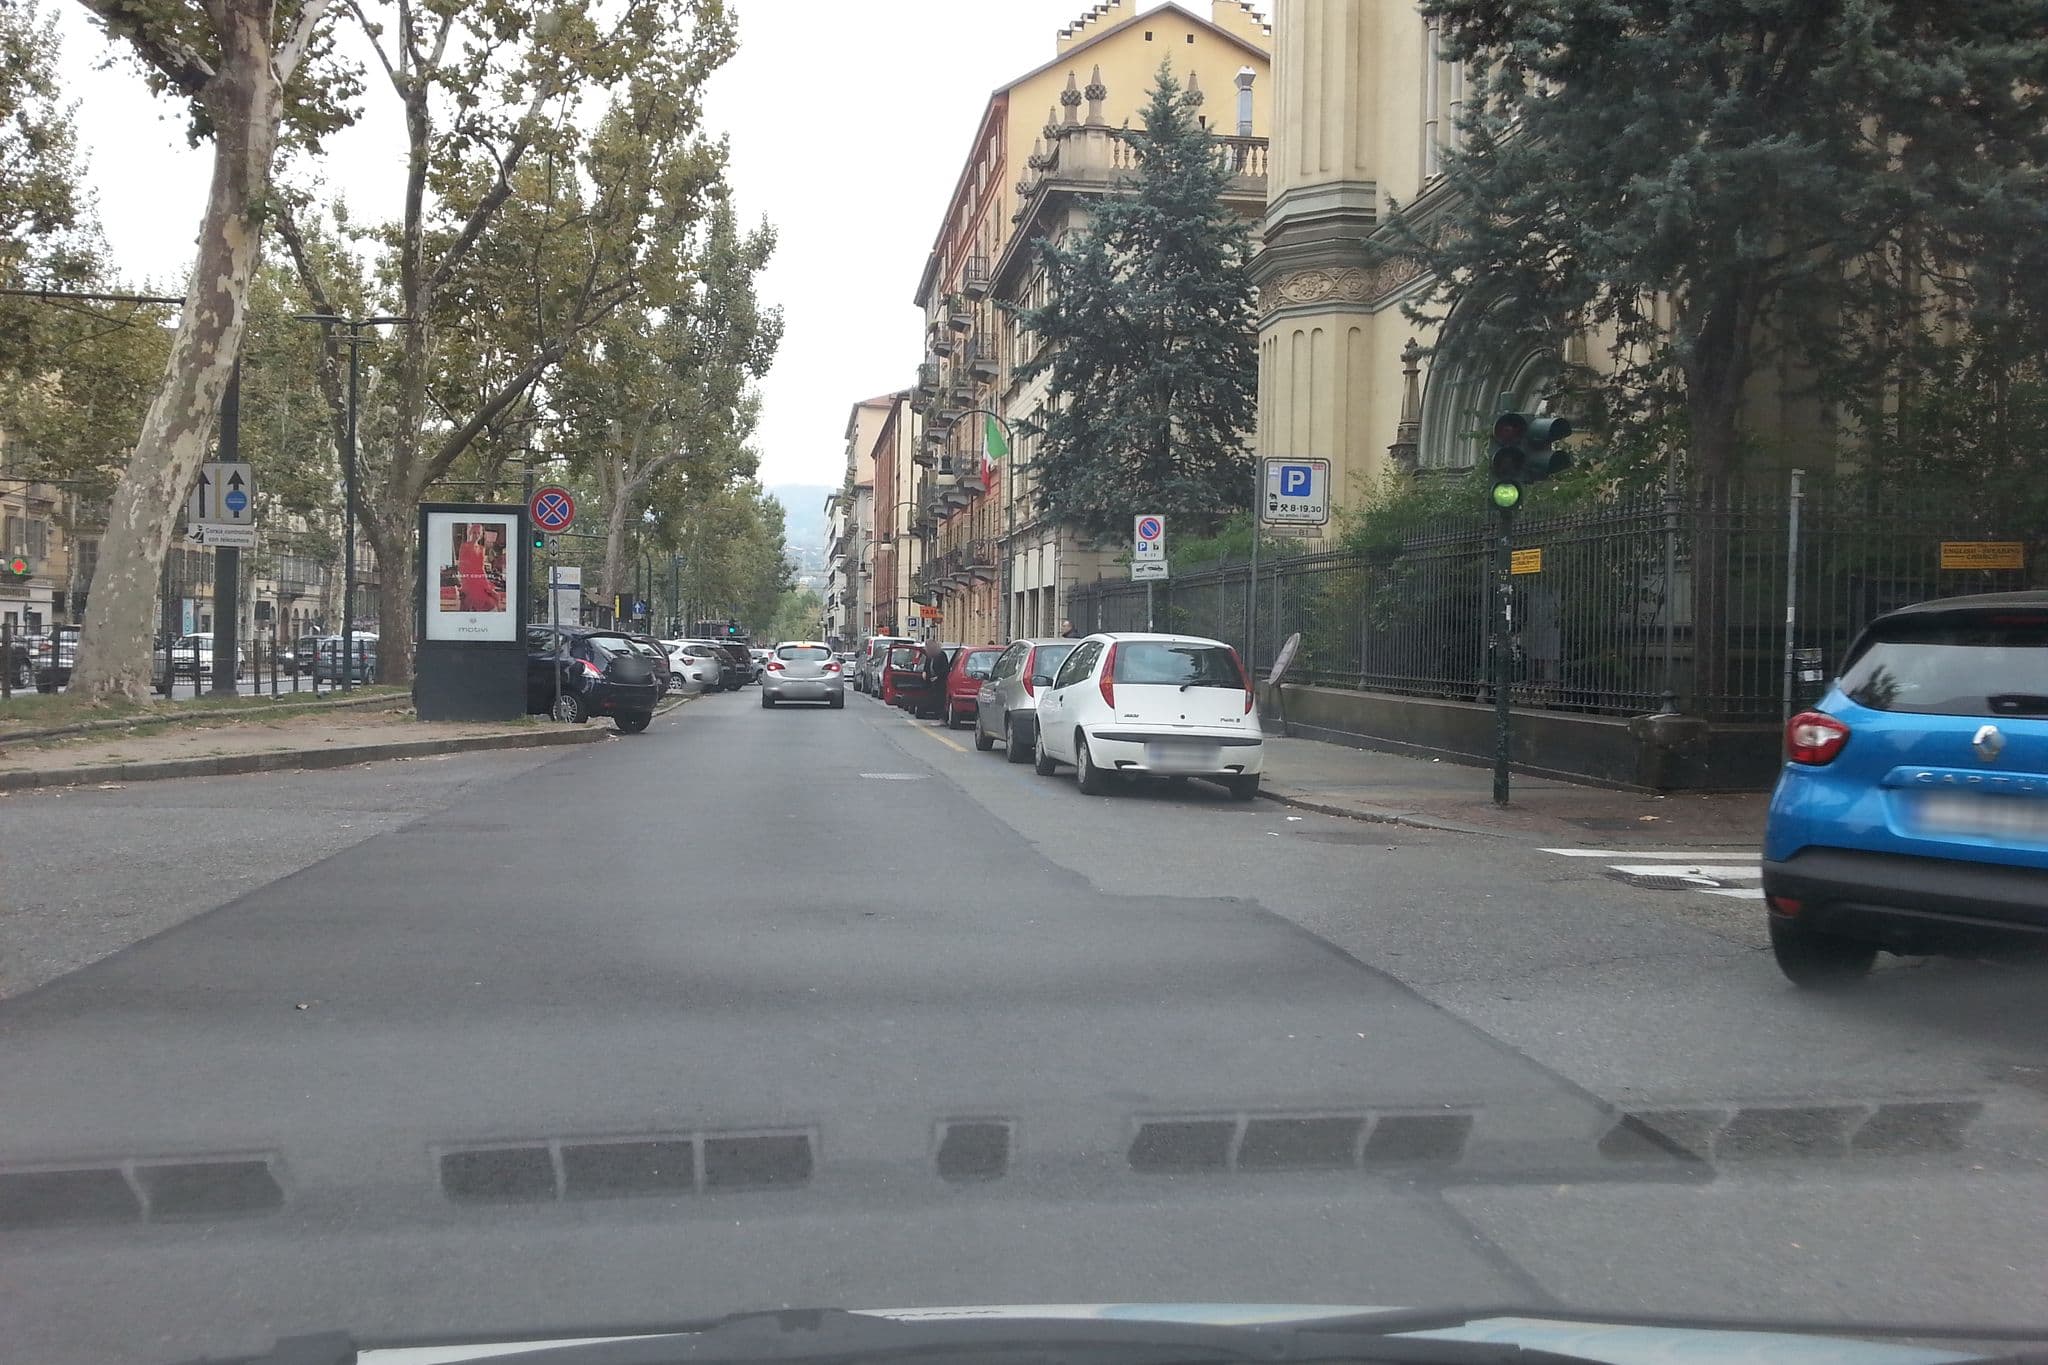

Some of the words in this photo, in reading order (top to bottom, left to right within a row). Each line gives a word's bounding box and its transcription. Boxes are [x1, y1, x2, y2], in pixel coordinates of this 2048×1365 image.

[1287, 470, 1305, 493] P
[1290, 504, 1322, 513] 8-19.30
[458, 625, 489, 633] motivi
[1916, 772, 2048, 790] CAPTU
